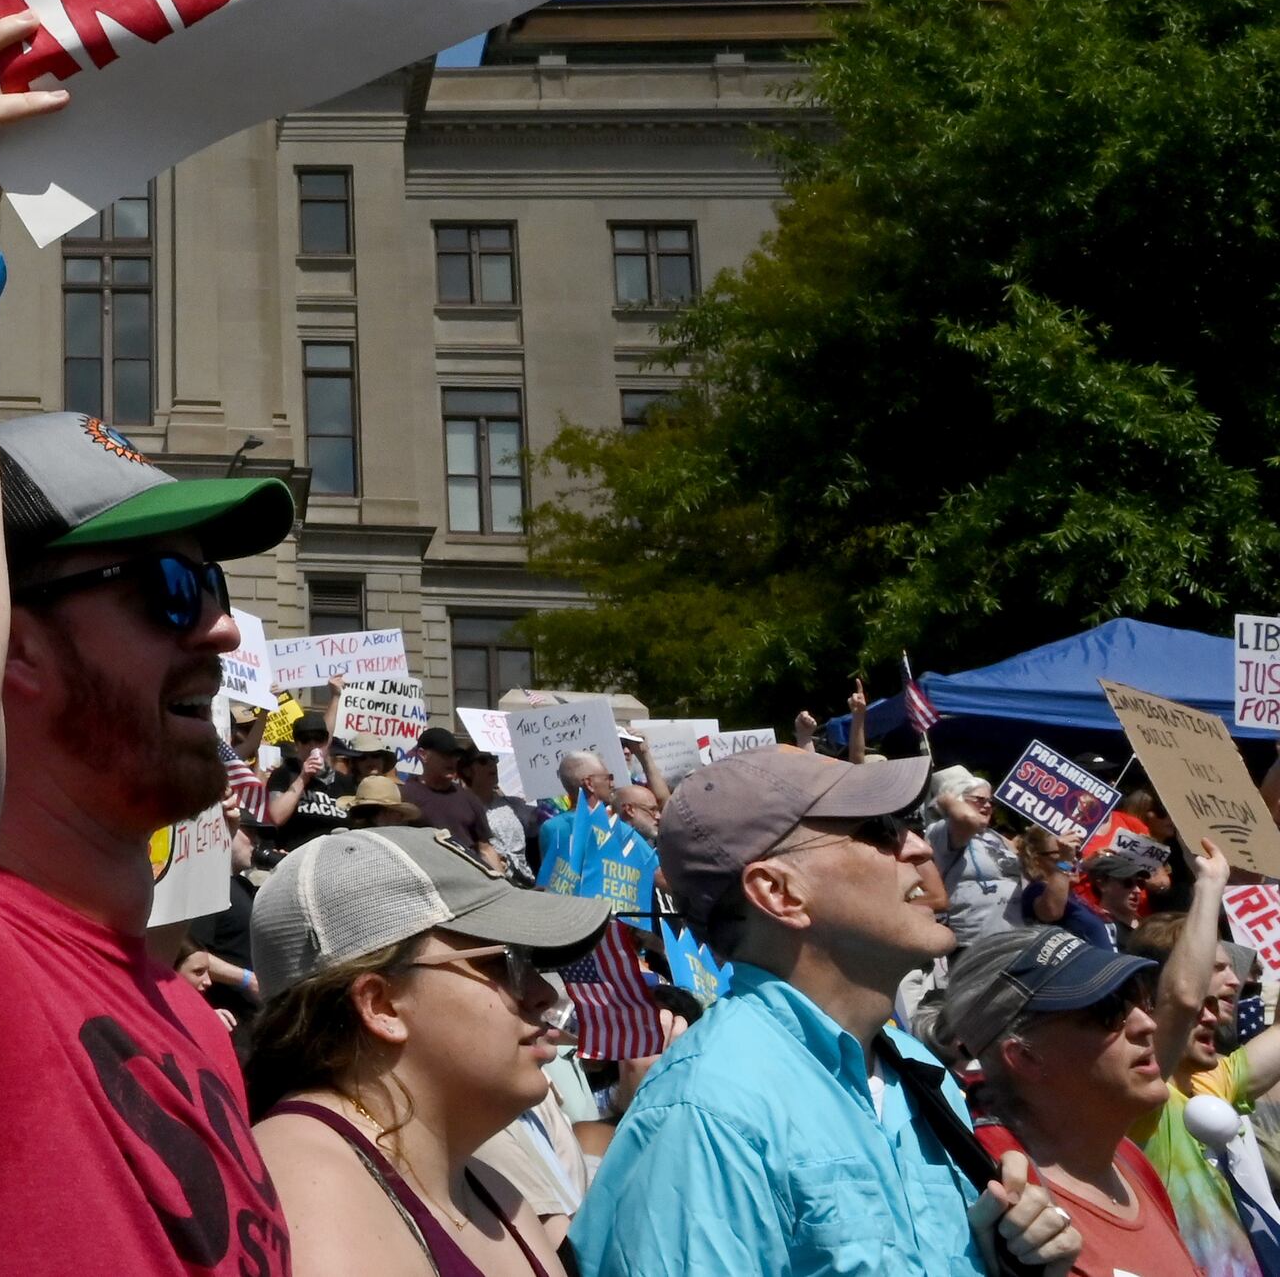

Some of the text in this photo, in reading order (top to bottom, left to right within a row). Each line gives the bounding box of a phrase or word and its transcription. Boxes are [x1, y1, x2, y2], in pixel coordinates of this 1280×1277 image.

[316, 638, 358, 656] TACO
[362, 632, 400, 647] ABOUT
[276, 665, 306, 683] THE
[345, 695, 398, 716] BECOMES
[1107, 688, 1223, 741] IMMIGRATION
[516, 719, 540, 736] THIS
[1137, 724, 1179, 748] BUILT
[542, 735, 552, 746] IS
[1016, 760, 1069, 800] STOP
[1030, 744, 1115, 804] PRO-AMERICA
[1180, 758, 1223, 784] THIS
[1005, 781, 1088, 839] TRUMP
[1185, 789, 1257, 825] NATION
[1116, 835, 1168, 862] WE ARE
[602, 859, 641, 882] TRUMP
[603, 878, 638, 902] FEARS
